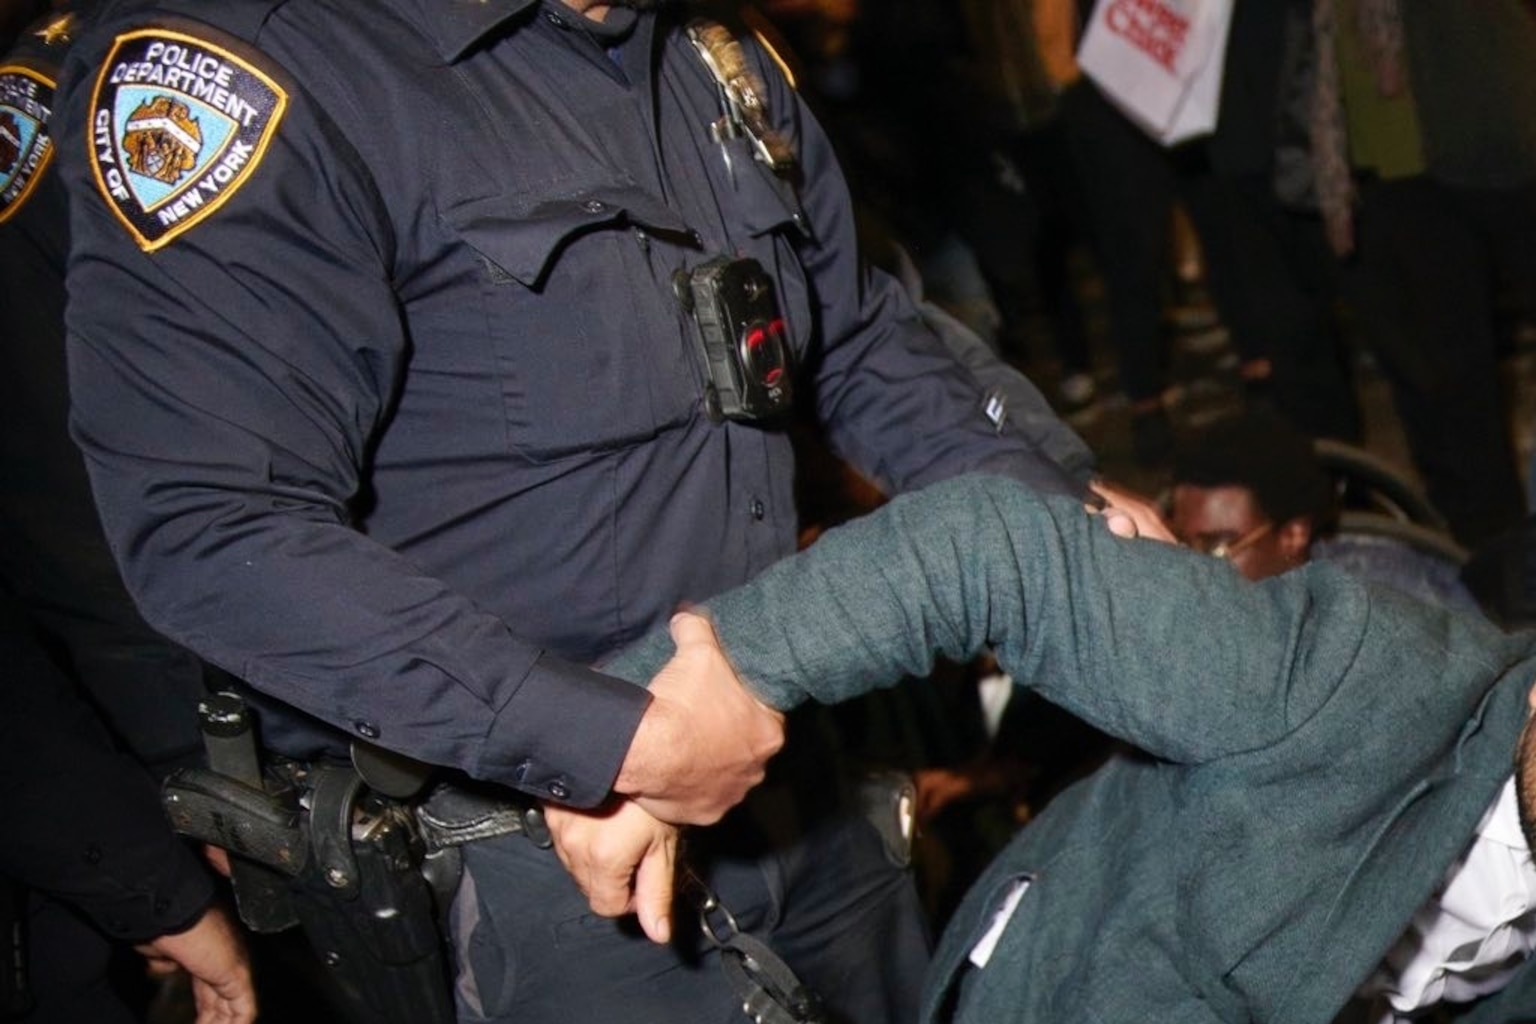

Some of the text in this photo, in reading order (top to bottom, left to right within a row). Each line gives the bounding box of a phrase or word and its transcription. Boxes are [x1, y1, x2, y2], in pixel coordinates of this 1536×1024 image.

[111, 62, 258, 127] DEPARTMENT
[146, 43, 234, 87] POLICE
[22, 132, 50, 175] YORK
[94, 108, 130, 203] CITY OF
[158, 141, 254, 226] NEW YORK
